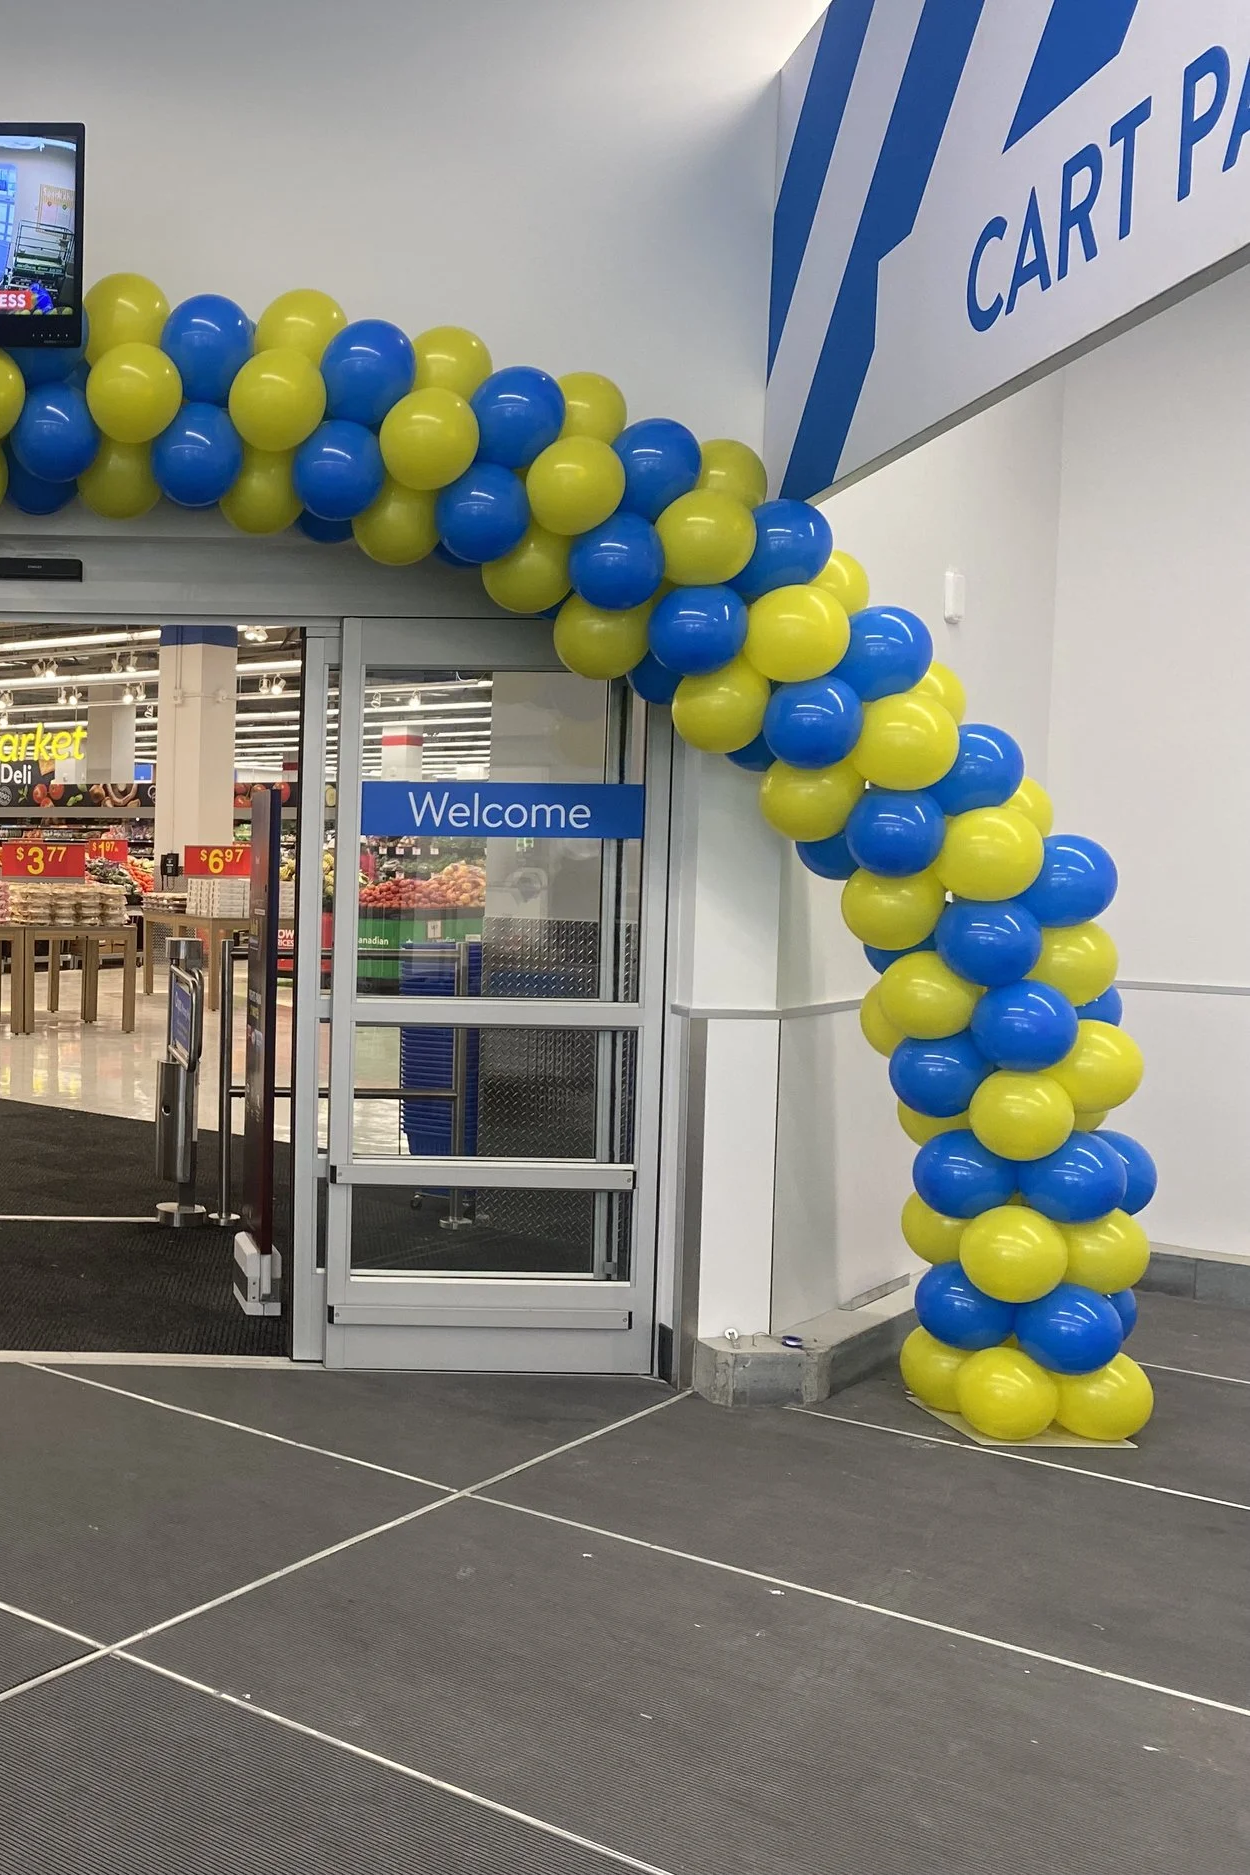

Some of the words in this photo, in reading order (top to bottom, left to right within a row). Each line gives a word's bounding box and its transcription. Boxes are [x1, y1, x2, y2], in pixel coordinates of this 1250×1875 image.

[966, 95, 1153, 333] CART
[0, 764, 32, 784] Deli
[408, 791, 591, 829] Welcome
[278, 929, 295, 939] OW
[358, 935, 389, 945] anadian
